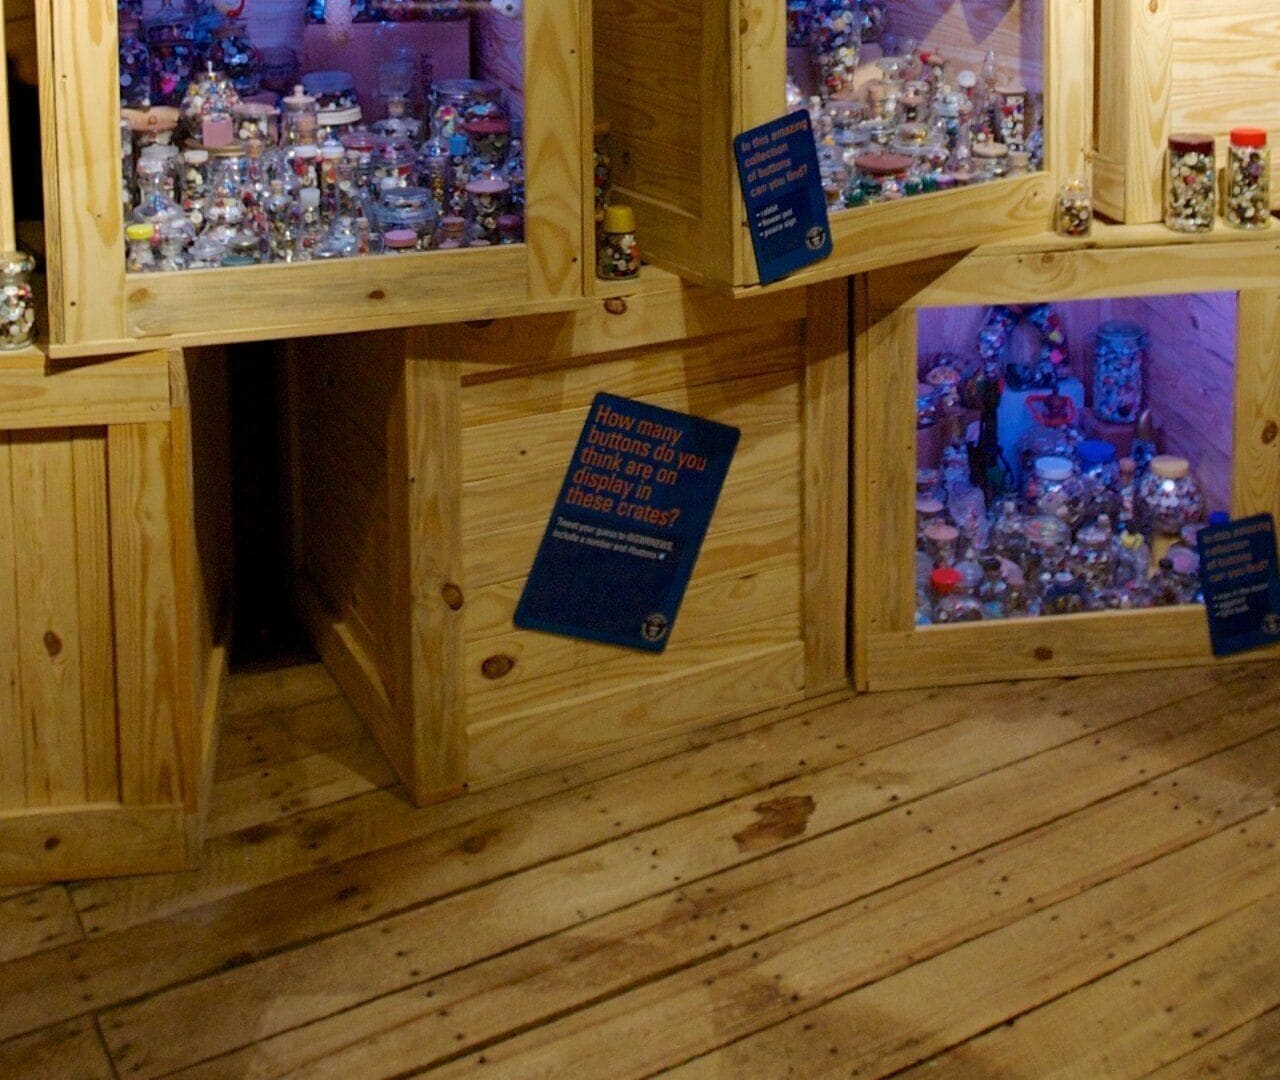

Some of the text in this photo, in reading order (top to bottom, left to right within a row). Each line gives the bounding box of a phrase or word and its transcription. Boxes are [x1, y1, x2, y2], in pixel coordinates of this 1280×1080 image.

[752, 135, 769, 148] this
[770, 120, 808, 140] amazing
[745, 143, 788, 167] collection
[747, 159, 792, 182] of buttons
[750, 163, 808, 197] can you find?
[595, 404, 683, 447] How many
[580, 446, 678, 485] think are on
[588, 425, 708, 471] buttons do you
[573, 466, 652, 501] display in
[565, 486, 681, 527] these crates?
